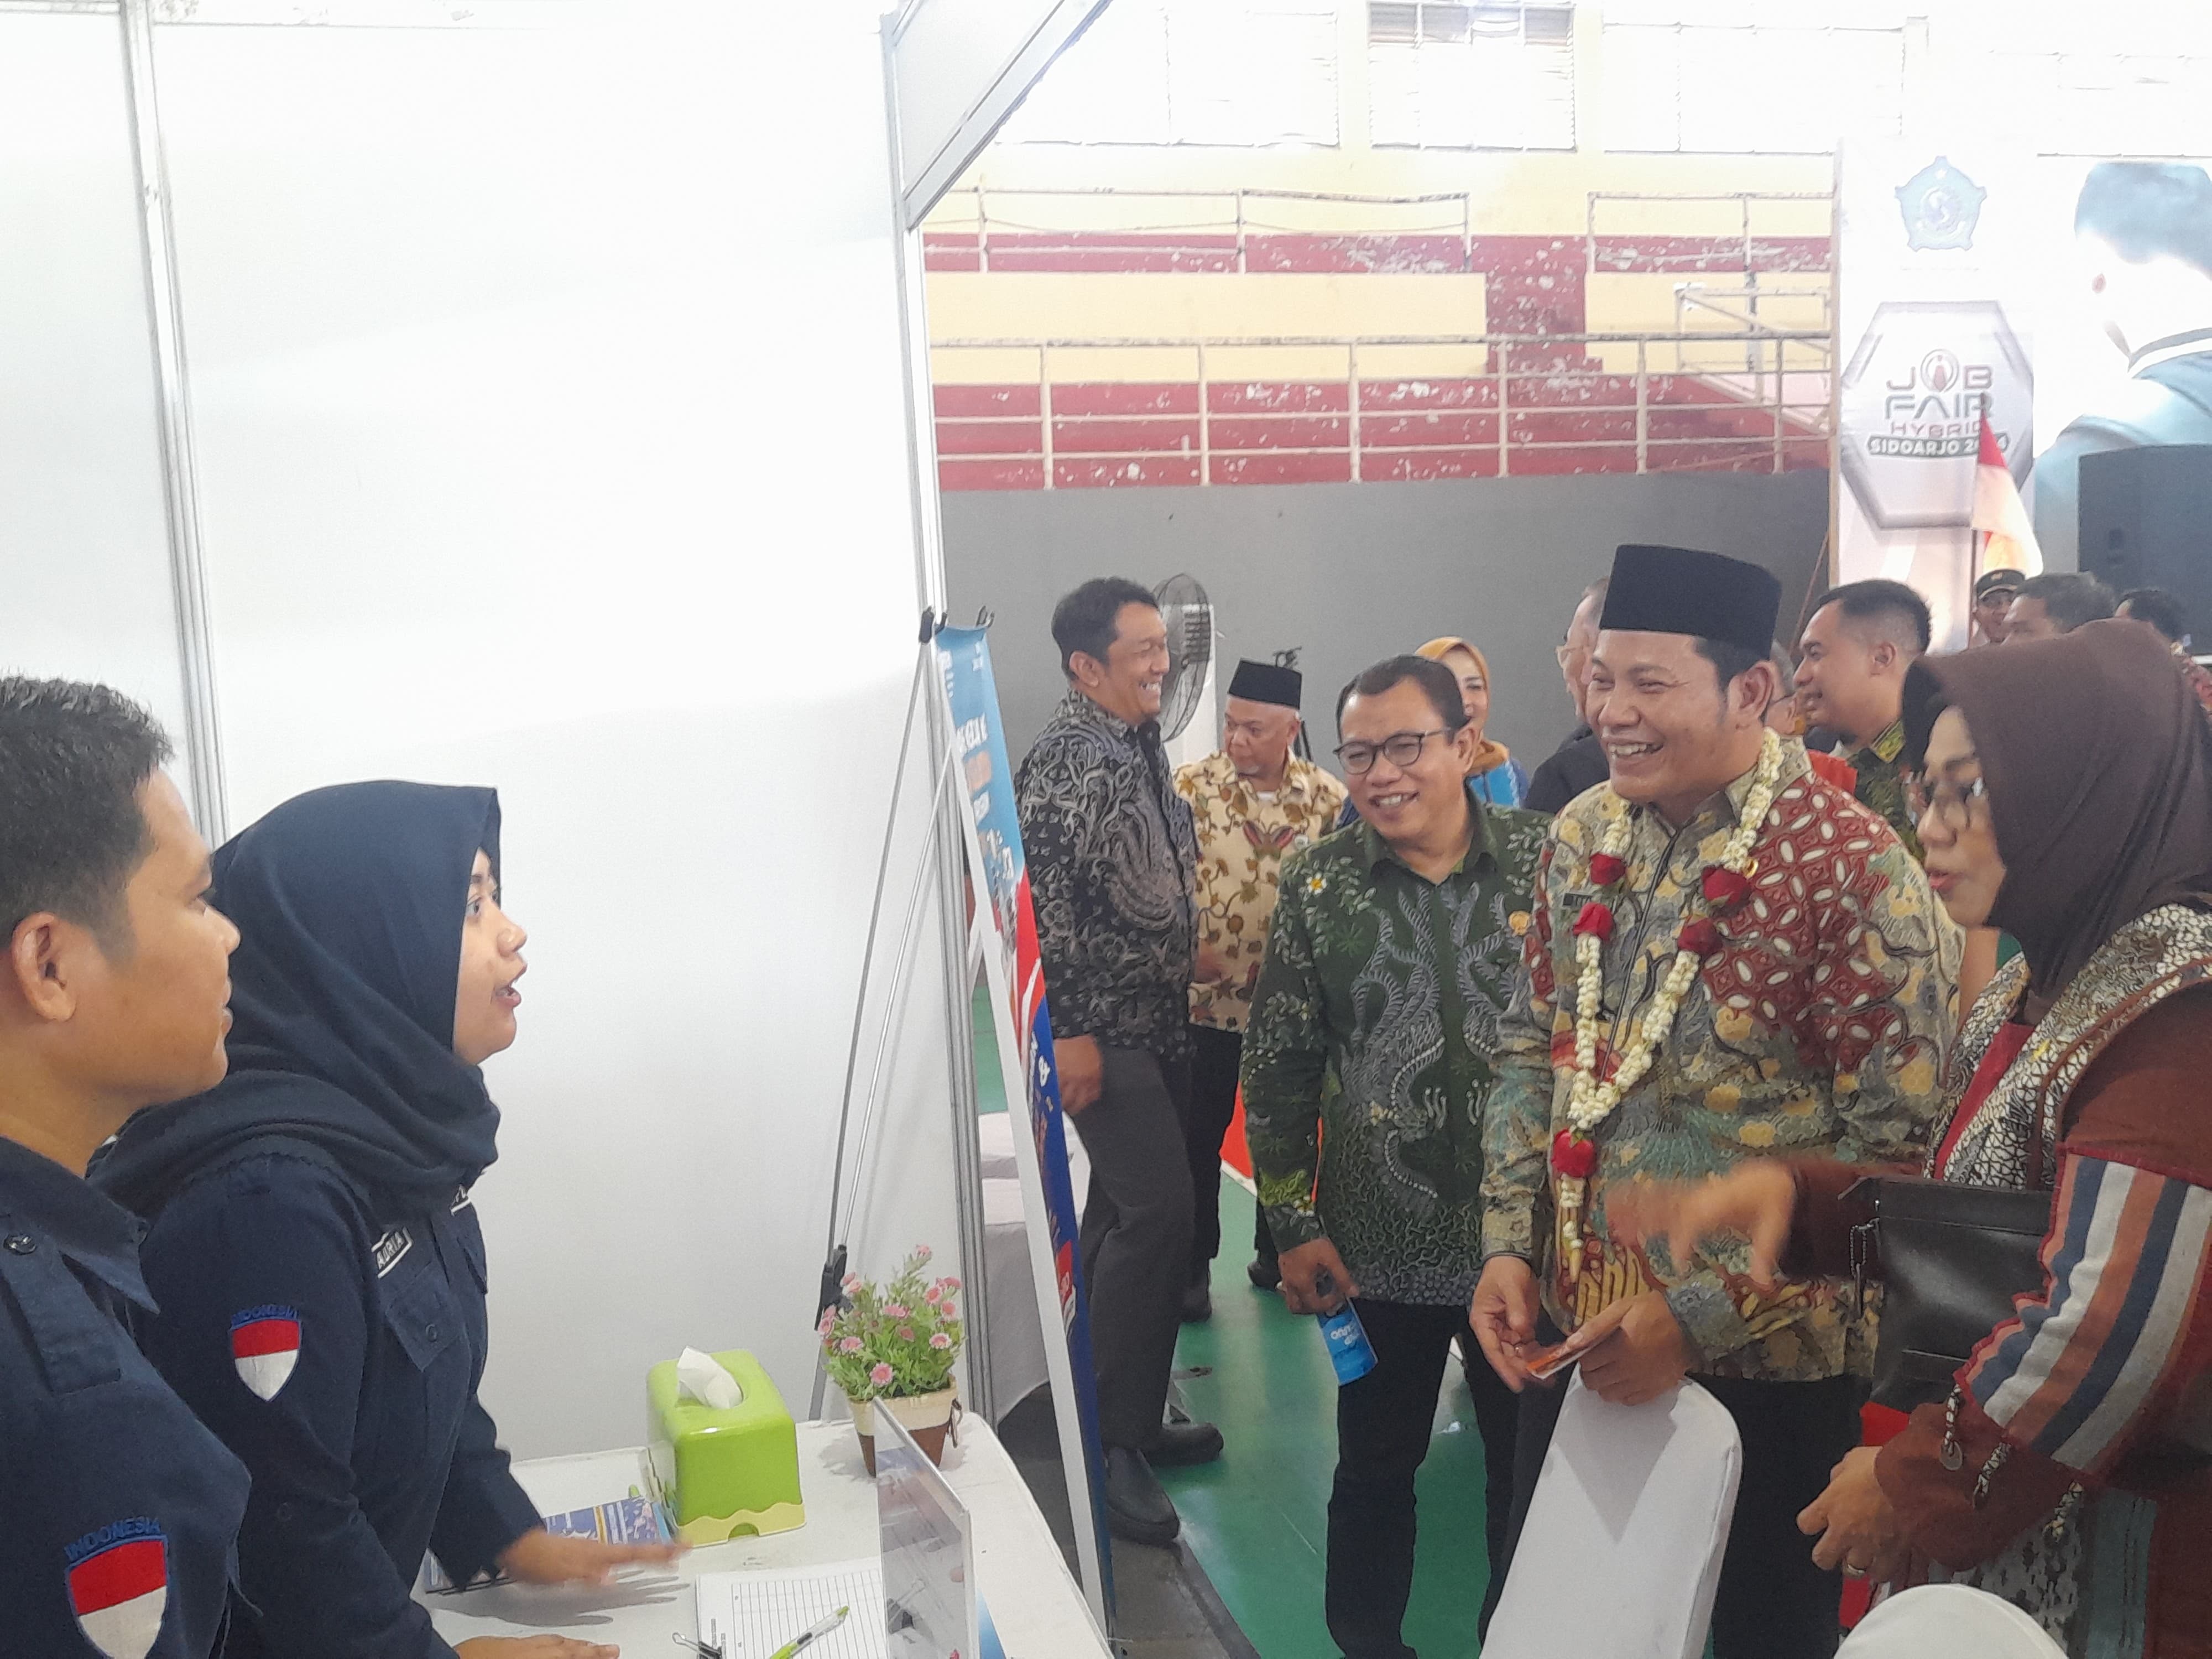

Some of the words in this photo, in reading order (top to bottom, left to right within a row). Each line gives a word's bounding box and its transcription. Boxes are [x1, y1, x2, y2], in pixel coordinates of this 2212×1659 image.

[1886, 348, 1993, 392] JOB
[1884, 393, 1994, 420] FAIR
[1870, 438, 1959, 454] SIDOARJO
[64, 1516, 161, 1561] INDONESIA
